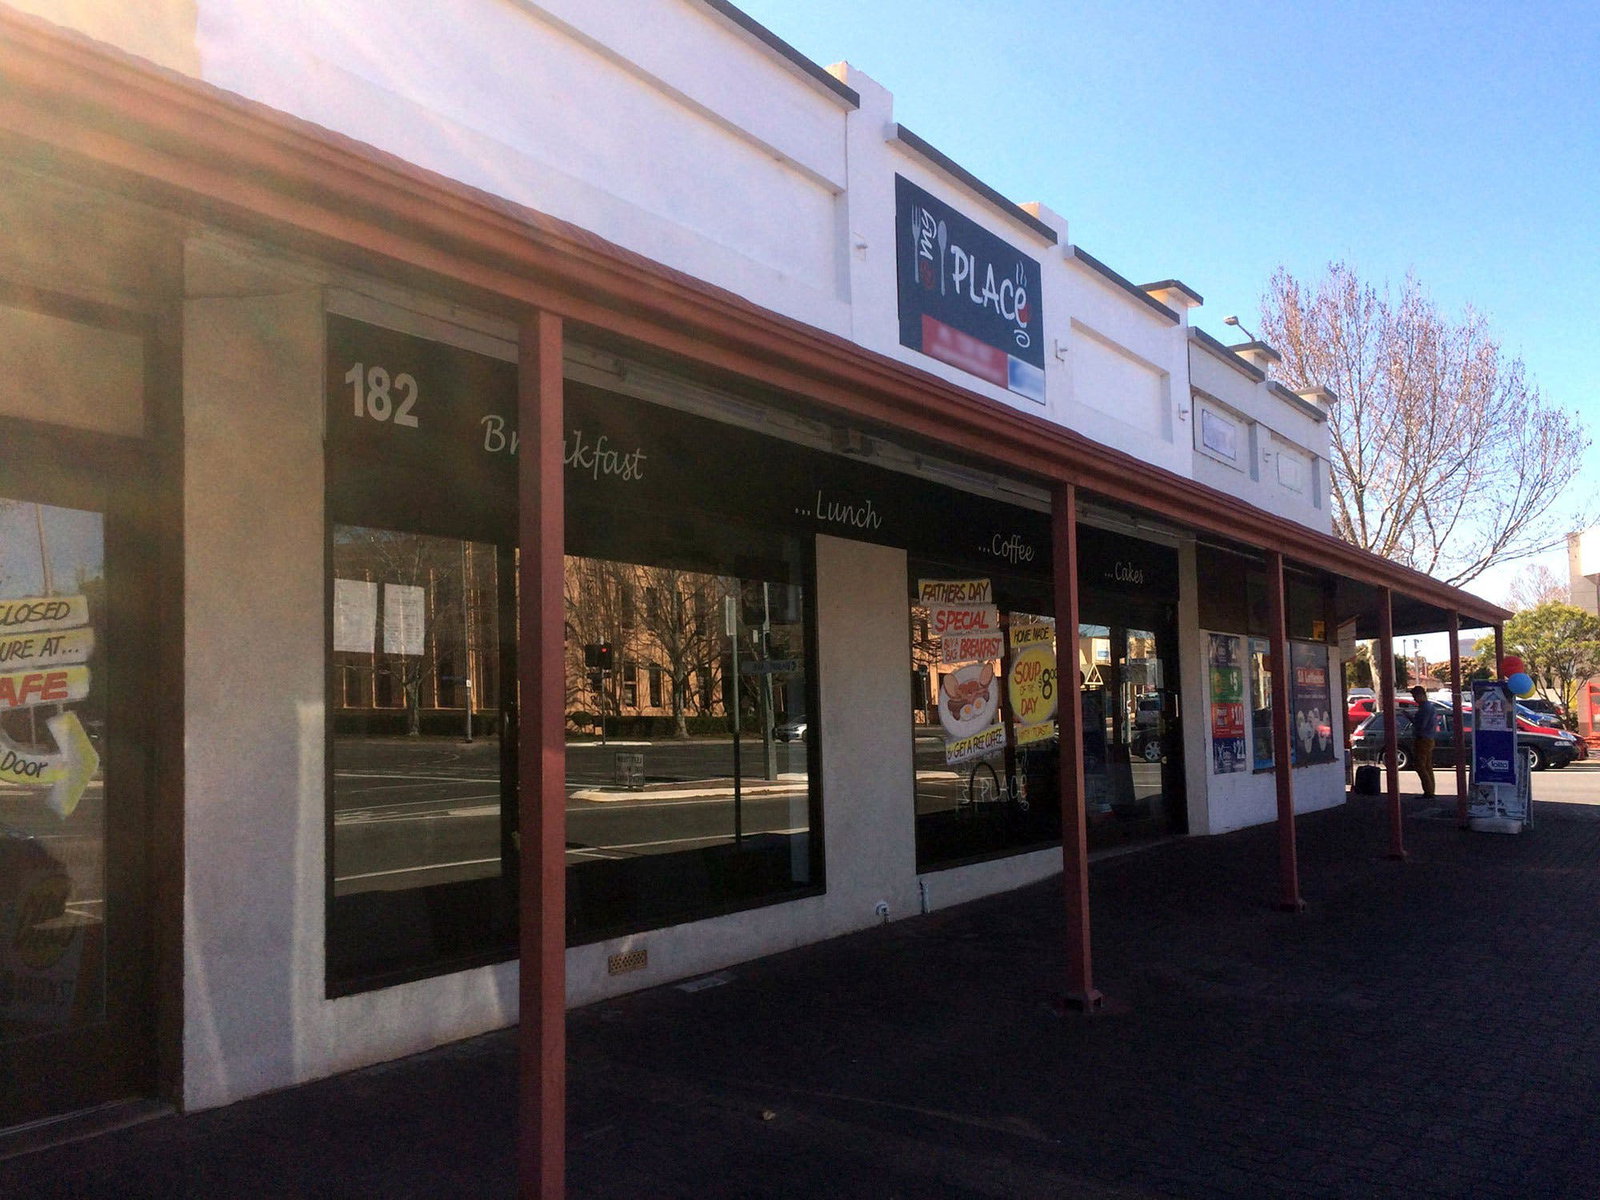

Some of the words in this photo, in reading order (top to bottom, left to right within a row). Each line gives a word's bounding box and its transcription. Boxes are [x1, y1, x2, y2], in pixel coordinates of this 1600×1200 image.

[920, 208, 937, 261] my
[344, 362, 419, 428] 182
[480, 414, 648, 481] Brkfast
[921, 583, 966, 602] FATHERS
[968, 582, 989, 601] DAY
[935, 610, 990, 633] SPECIAL
[1014, 661, 1041, 685] SOUP
[1021, 697, 1038, 716] DAY
[1, 751, 48, 778] Door
